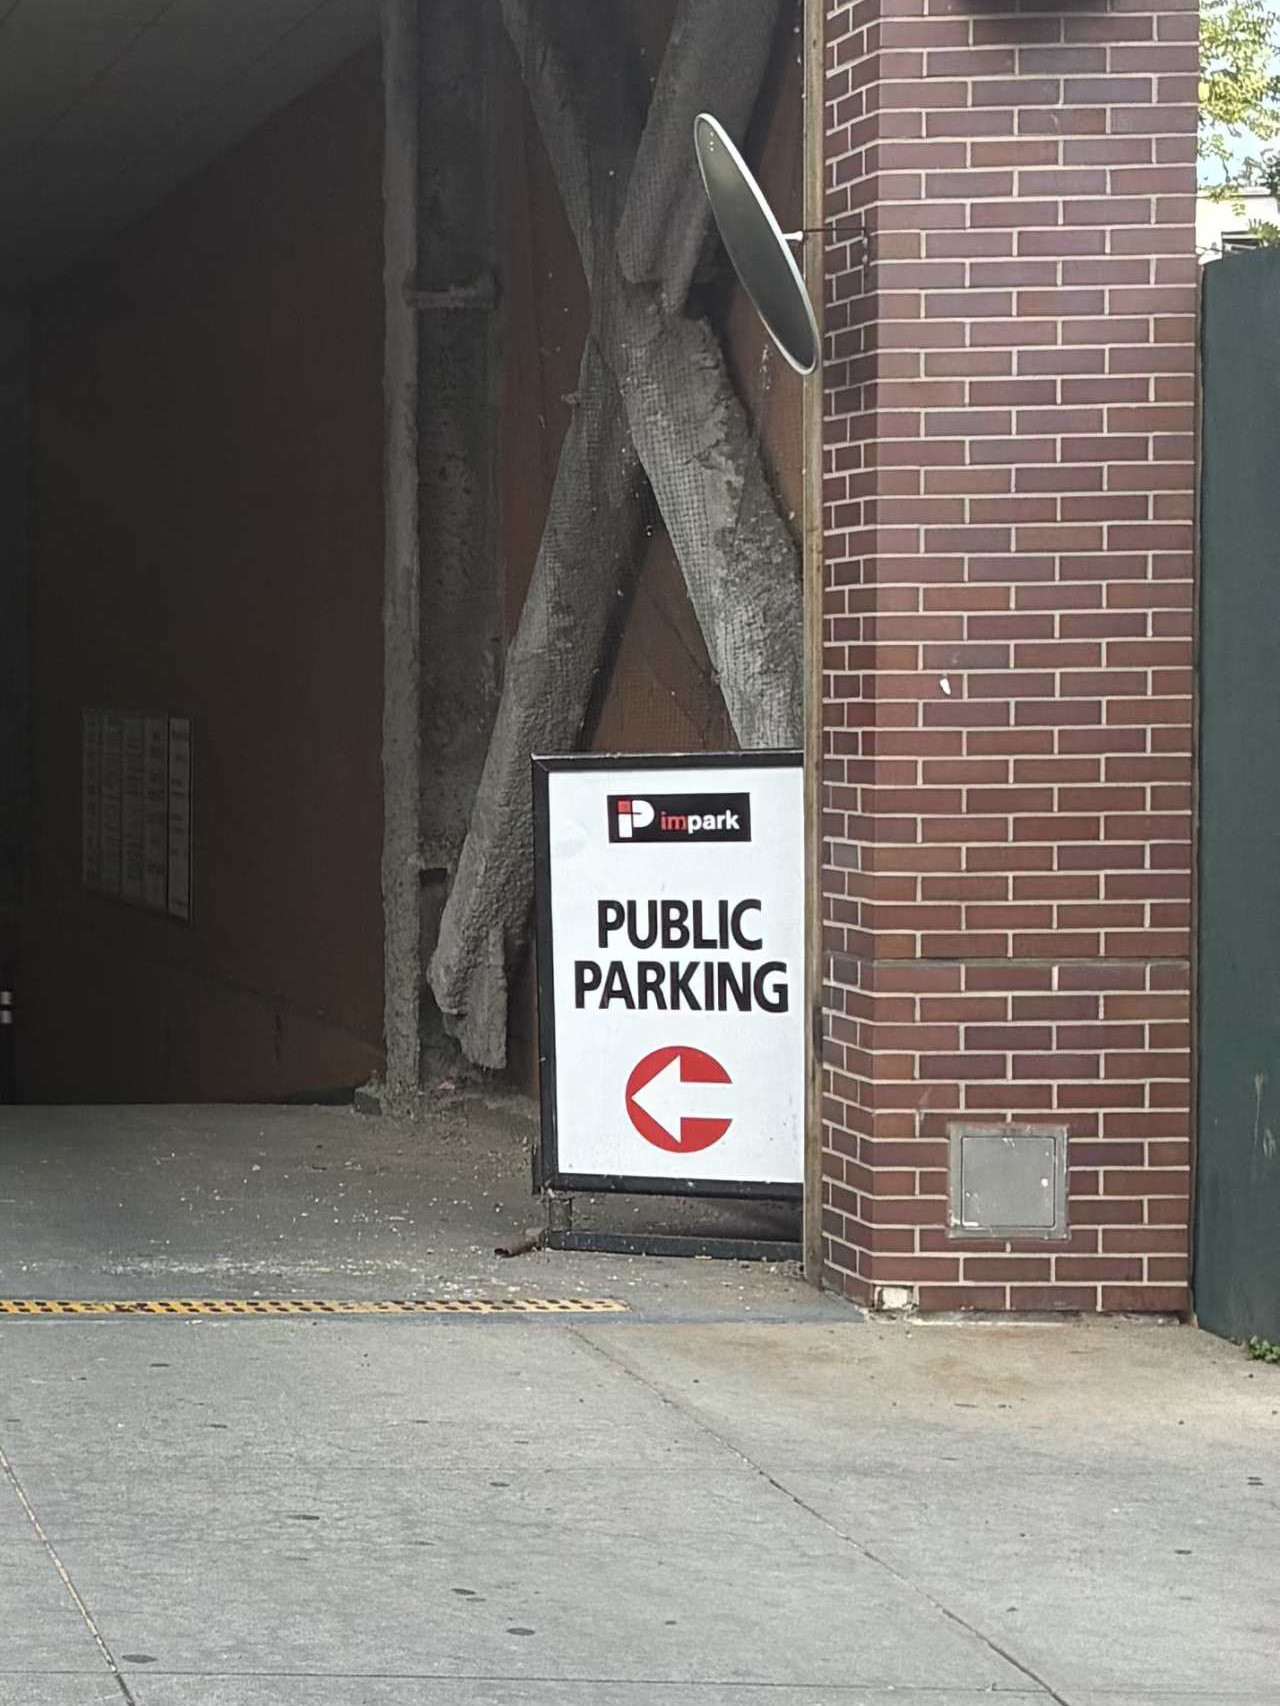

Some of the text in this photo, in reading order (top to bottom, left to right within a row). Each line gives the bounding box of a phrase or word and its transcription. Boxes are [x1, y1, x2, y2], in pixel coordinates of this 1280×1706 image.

[660, 809, 740, 834] impark
[597, 899, 763, 951] PUBLIC
[574, 960, 789, 1013] PARKING
